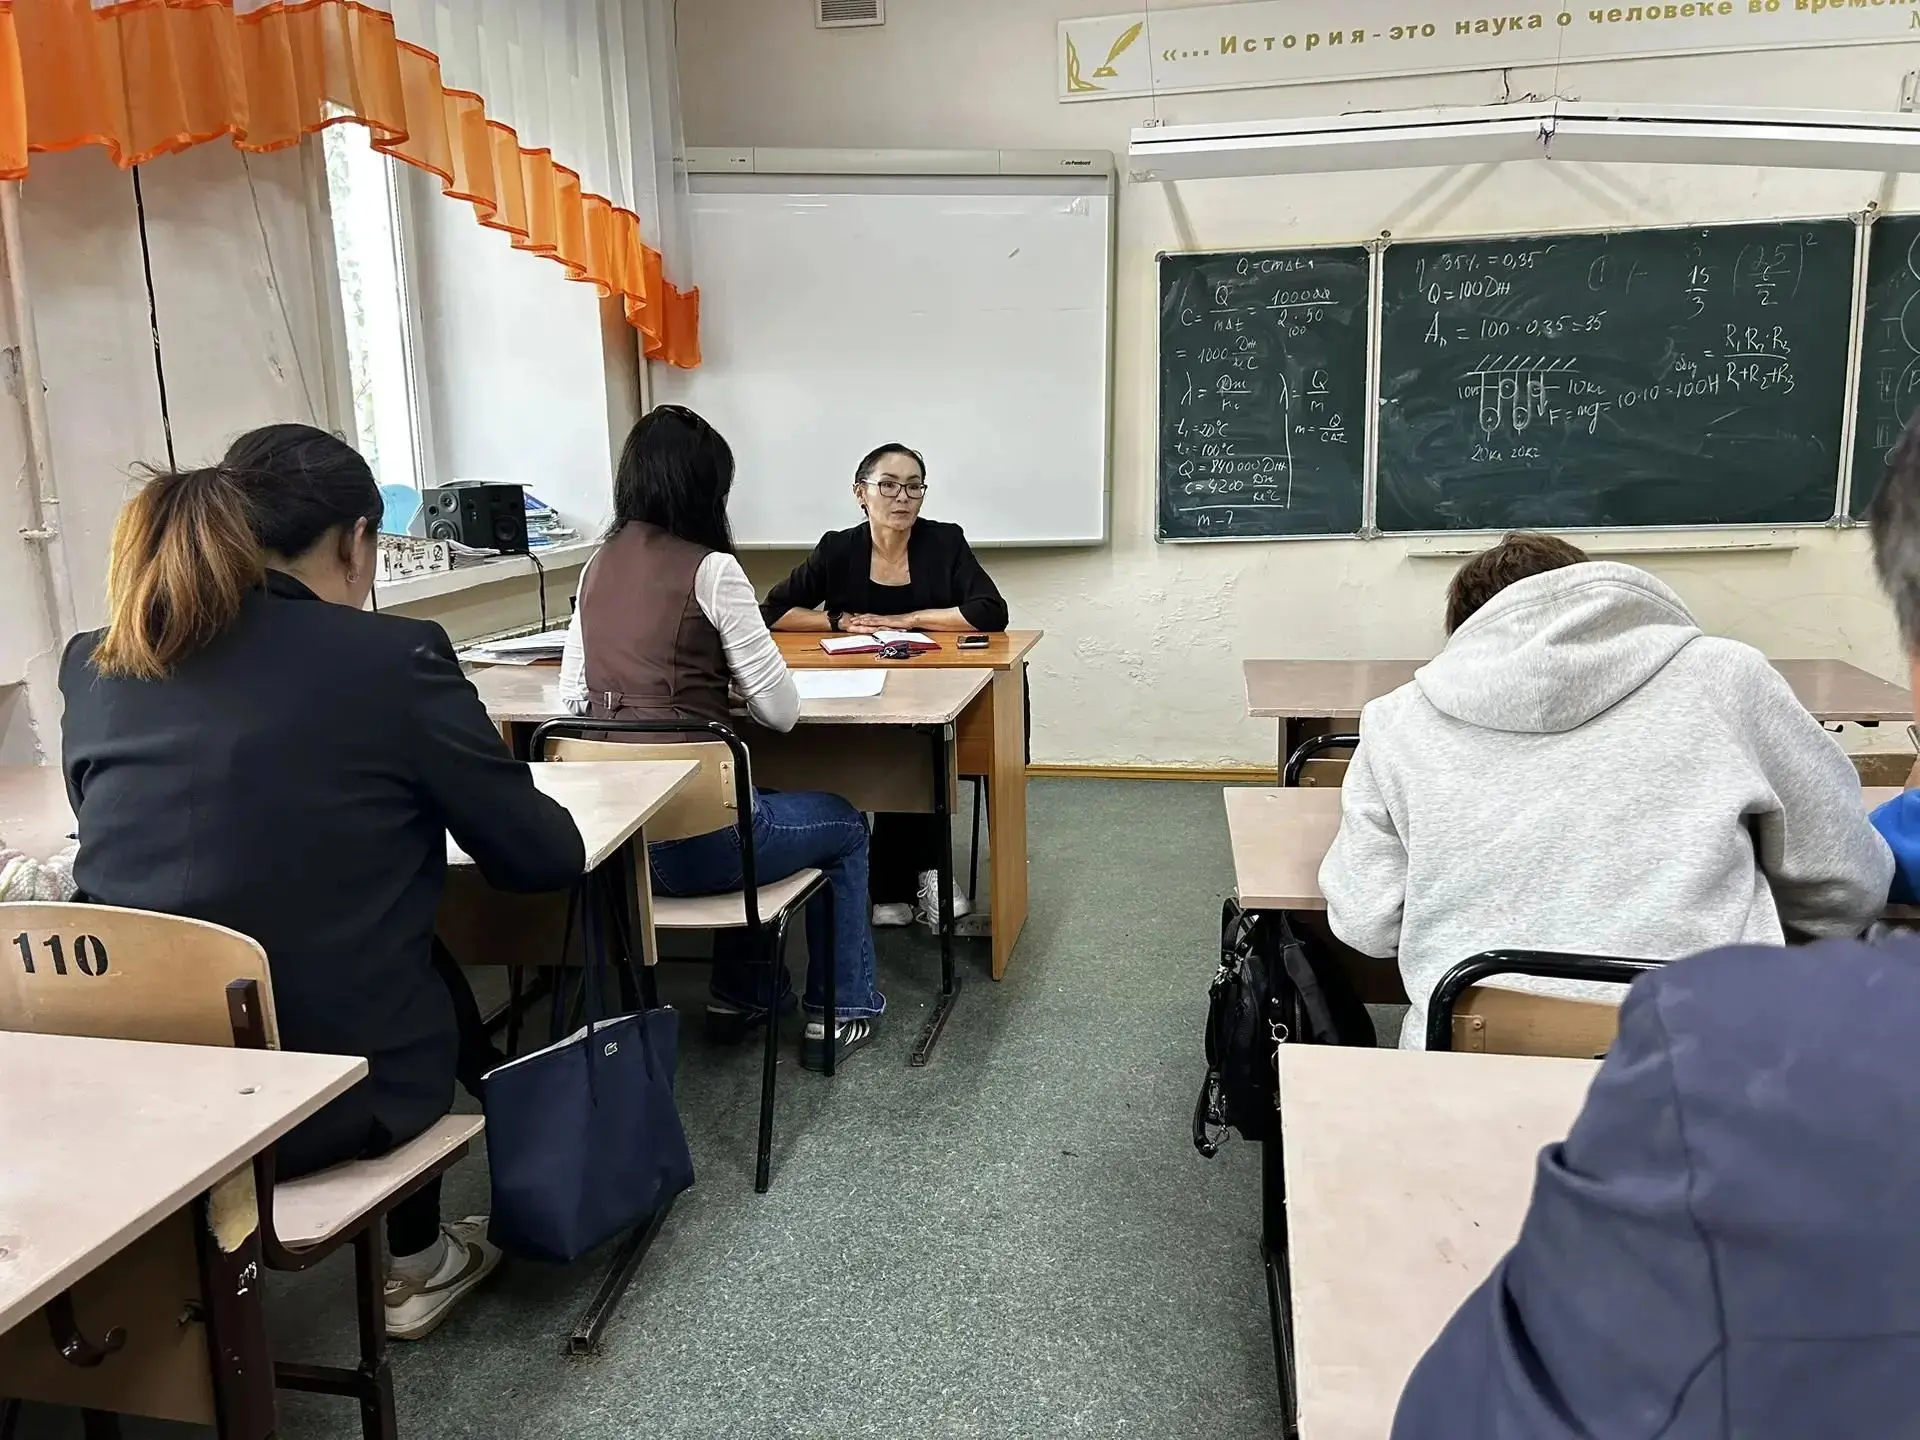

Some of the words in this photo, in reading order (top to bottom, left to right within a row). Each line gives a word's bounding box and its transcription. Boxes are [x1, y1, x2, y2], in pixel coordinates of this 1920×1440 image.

[1455, 12, 1543, 36] наука
[1556, 12, 1573, 26] о
[1588, 1, 1733, 23] человеке
[1748, 0, 1781, 13] во
[12, 932, 109, 977] 110
